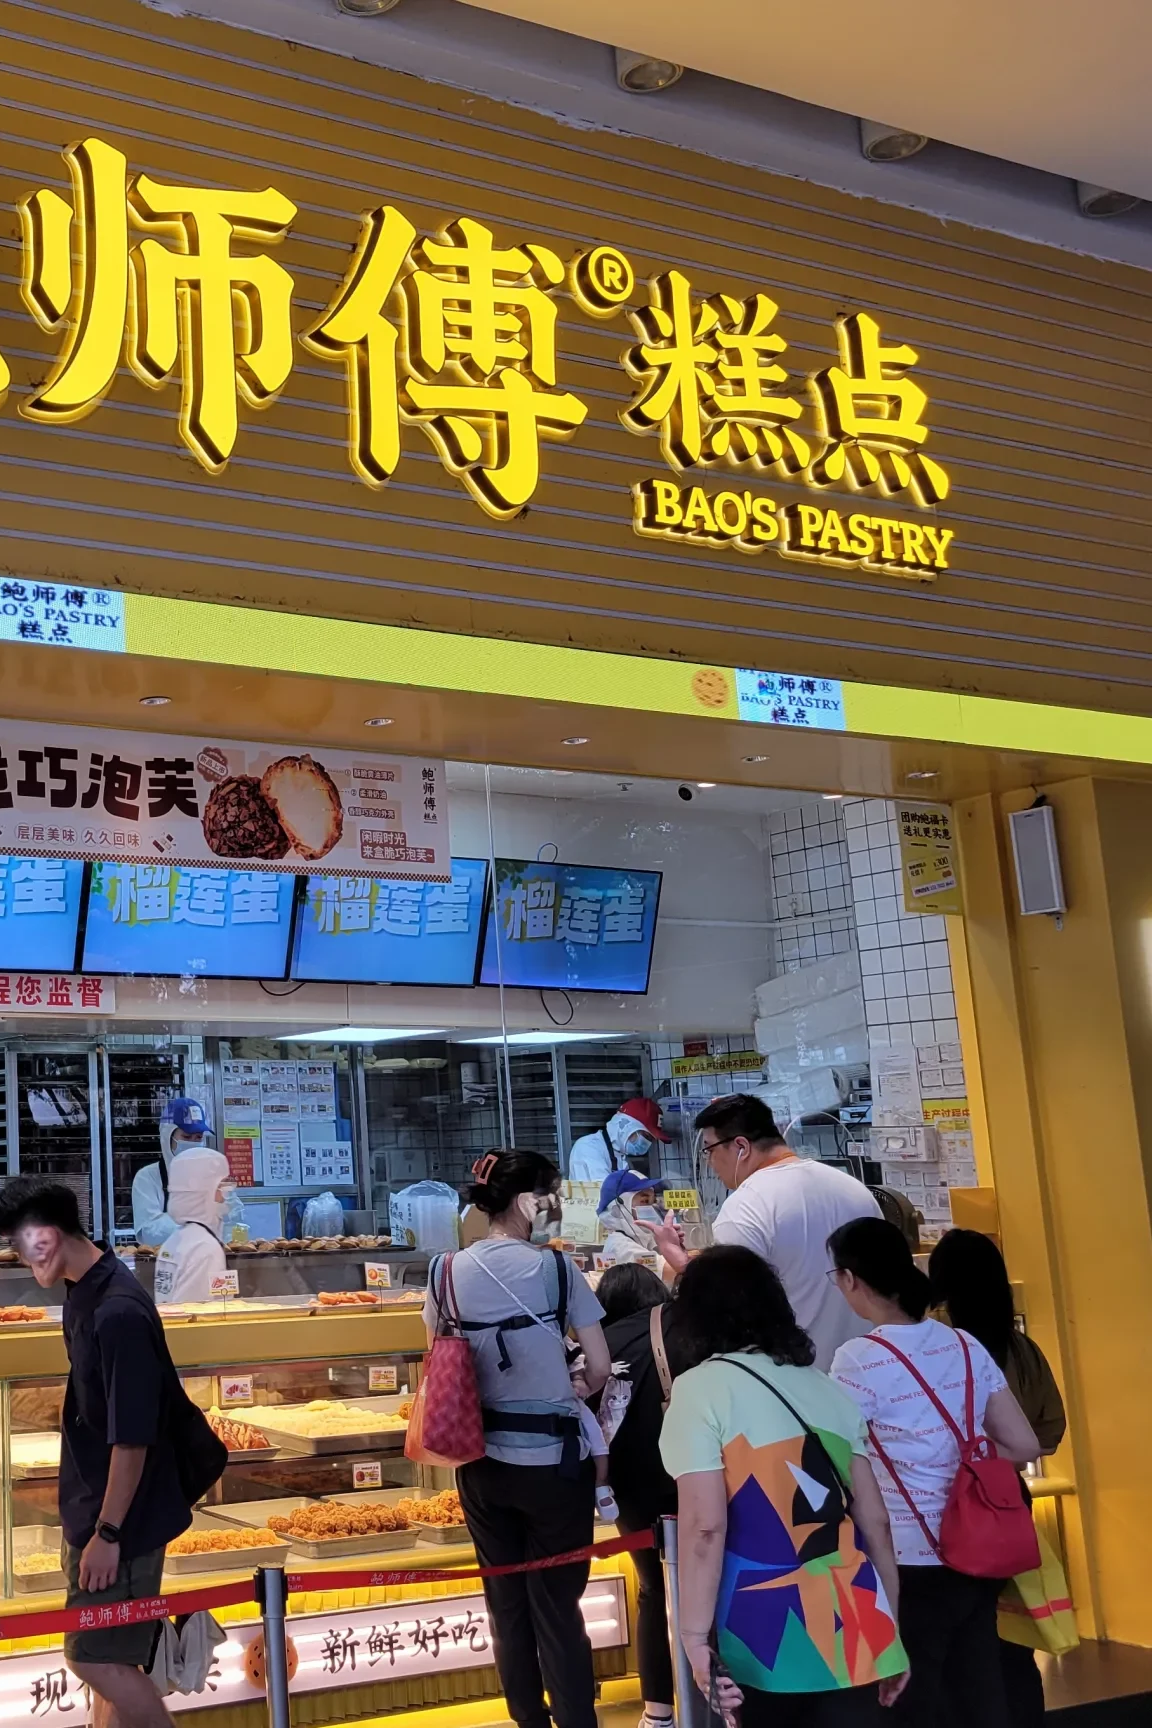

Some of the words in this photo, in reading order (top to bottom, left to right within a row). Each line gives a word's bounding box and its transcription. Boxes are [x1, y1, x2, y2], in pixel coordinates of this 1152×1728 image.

[648, 479, 779, 540] BAO'S
[794, 502, 954, 574] PASTRY
[44, 608, 120, 628] PASTRY
[17, 620, 73, 643] 糕点
[788, 695, 840, 711] PASTRY
[199, 754, 226, 775] 新品上市
[16, 824, 77, 845] 层层美味
[83, 828, 141, 849] 久久回味
[361, 831, 405, 845] 闲暇时光
[113, 865, 282, 928] 榴莲蛋
[317, 878, 472, 938] 榴莲蛋
[501, 881, 645, 947] 榴莲蛋
[320, 1610, 489, 1674] 新鲜好吃
